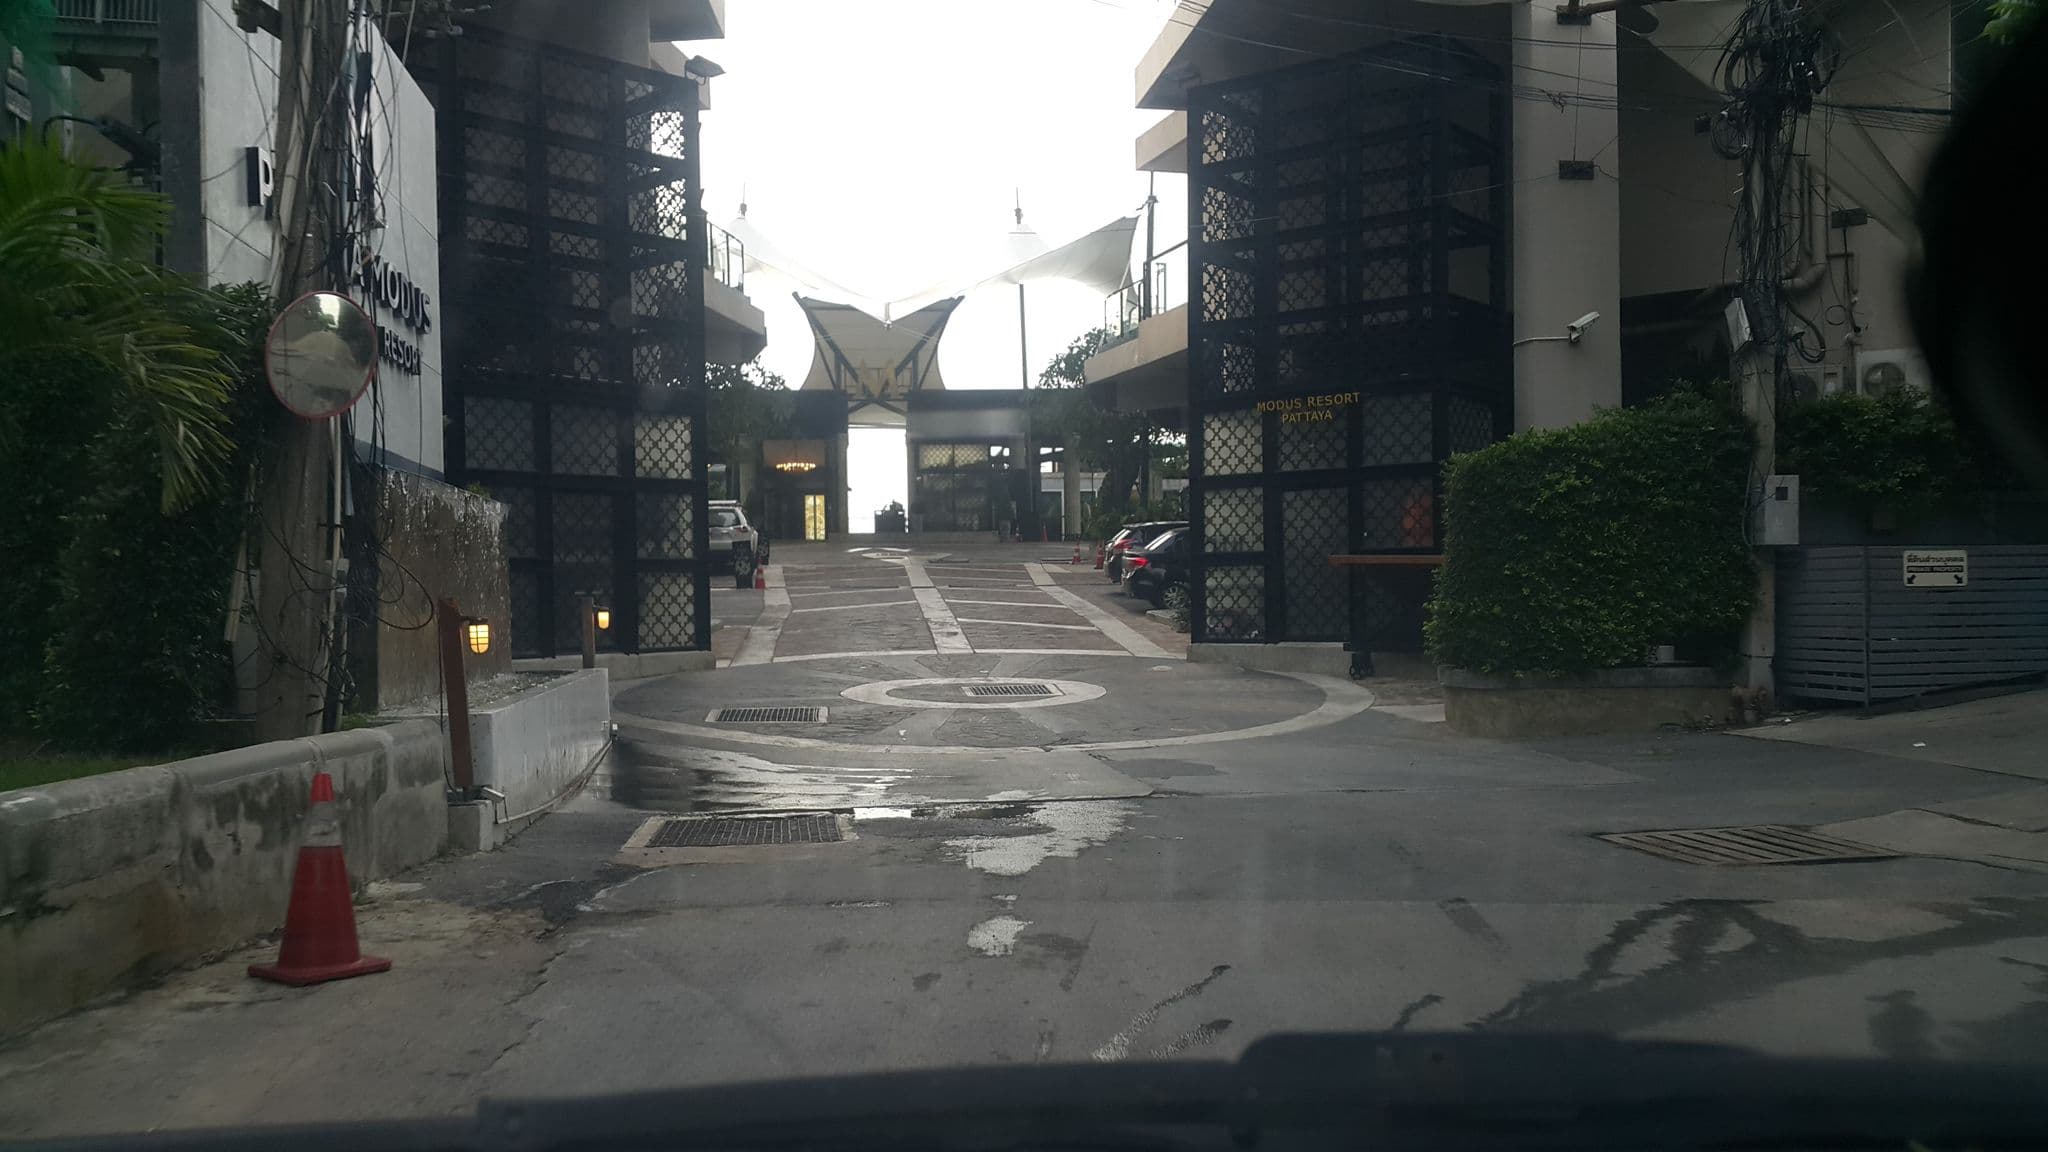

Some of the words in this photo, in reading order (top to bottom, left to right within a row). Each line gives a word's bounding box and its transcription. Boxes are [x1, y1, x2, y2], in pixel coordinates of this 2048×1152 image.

[372, 255, 432, 335] MODUS
[1257, 397, 1301, 412] MODUS
[1307, 392, 1360, 407] RESORT
[1282, 410, 1333, 424] PATTAYA
